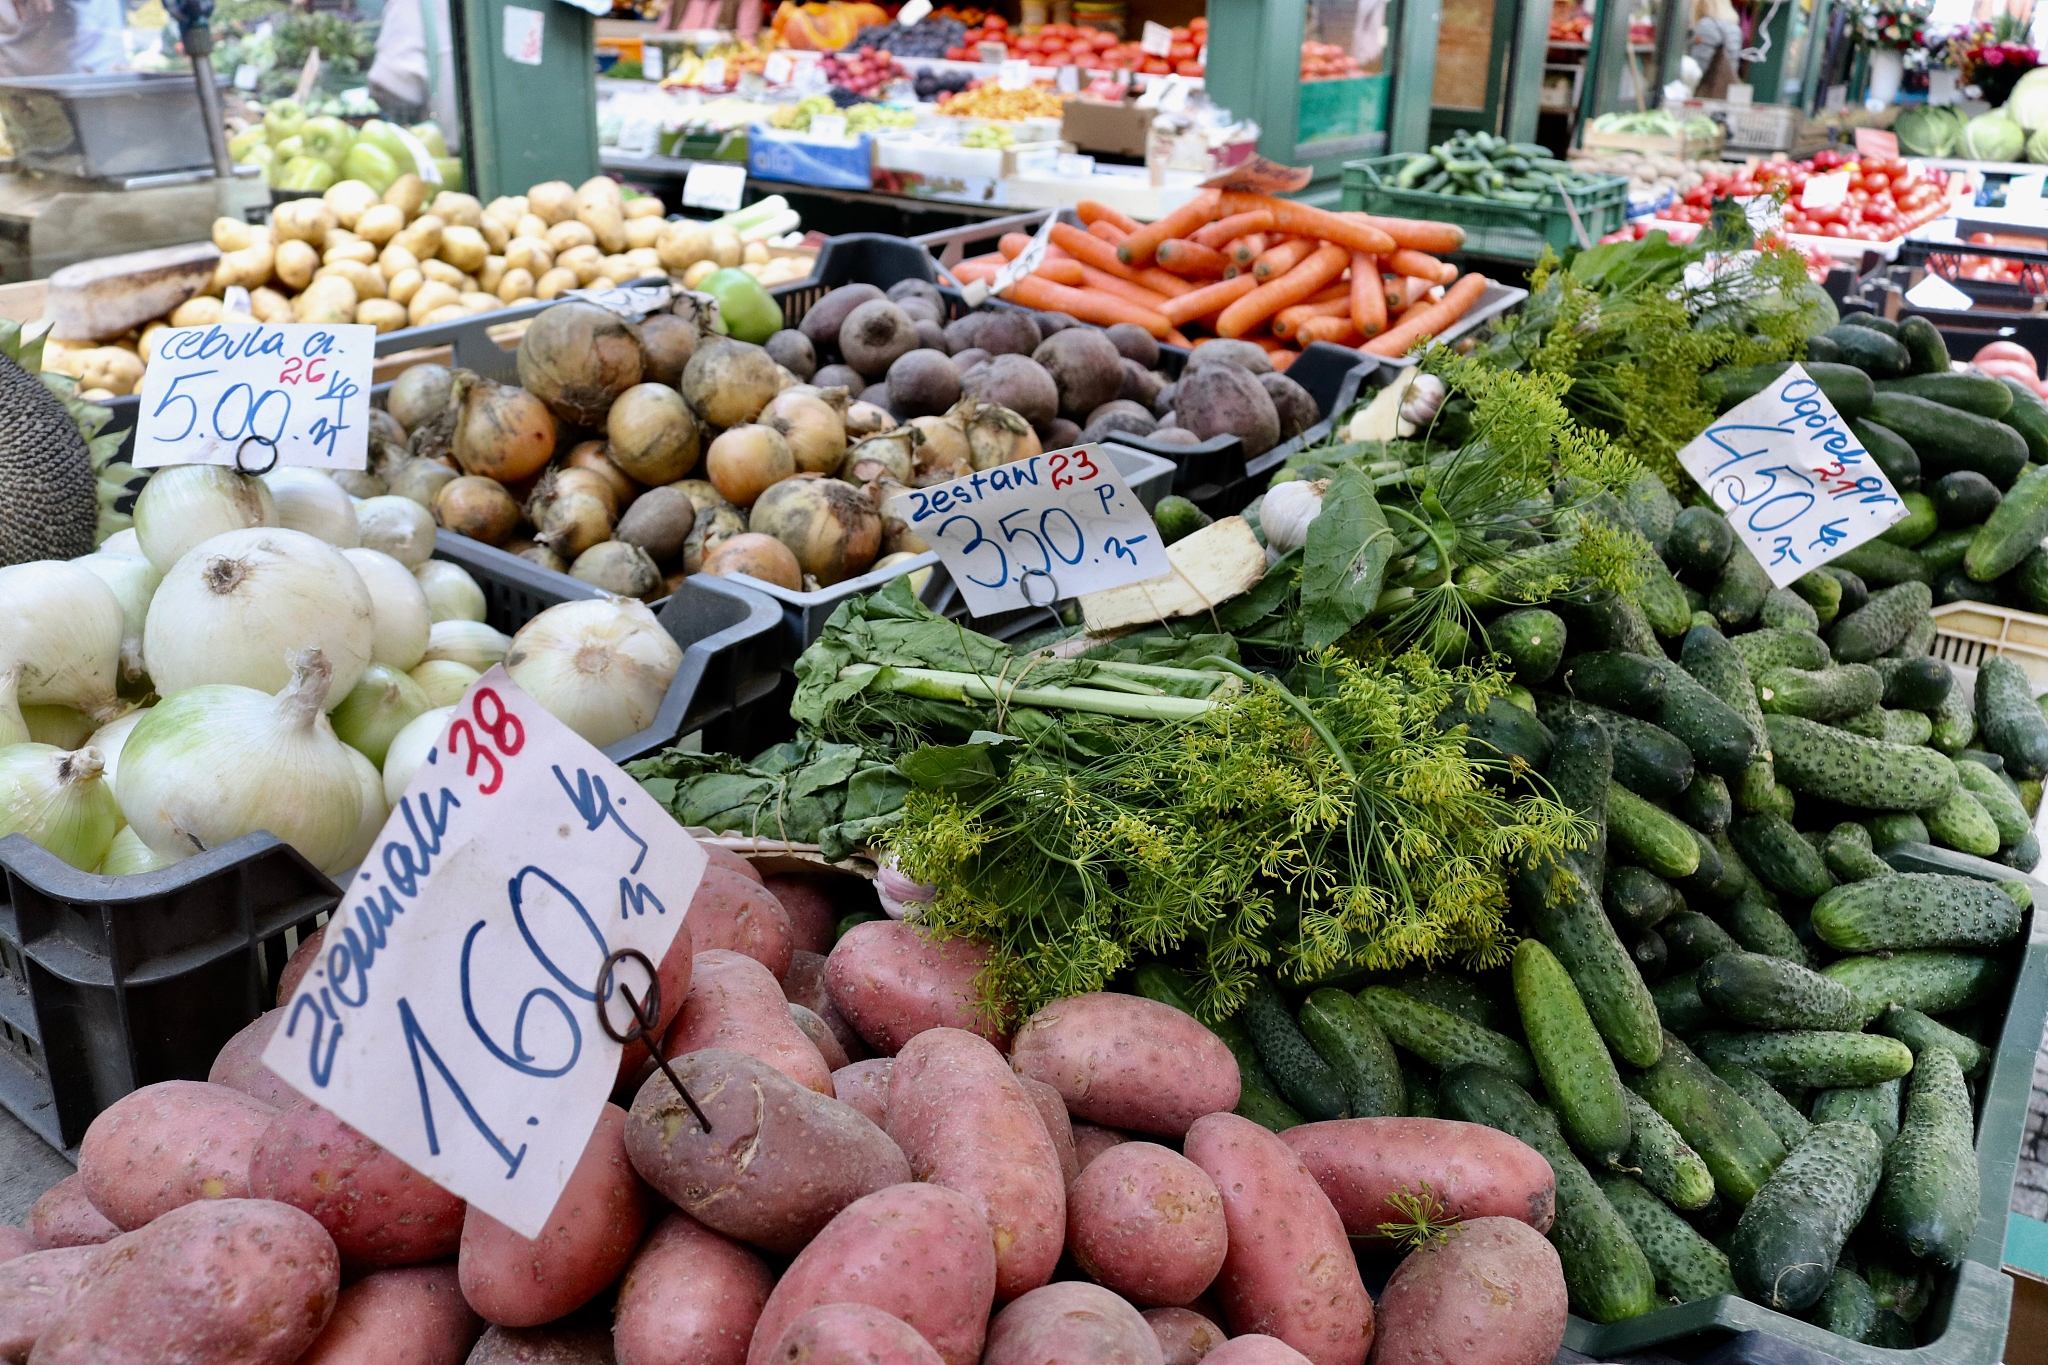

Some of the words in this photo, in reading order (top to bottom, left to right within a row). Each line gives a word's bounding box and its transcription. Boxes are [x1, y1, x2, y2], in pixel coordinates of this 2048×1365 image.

[280, 357, 326, 385] 26
[1048, 449, 1099, 490] 23
[1813, 461, 1857, 494] 21
[448, 687, 526, 796] 38
